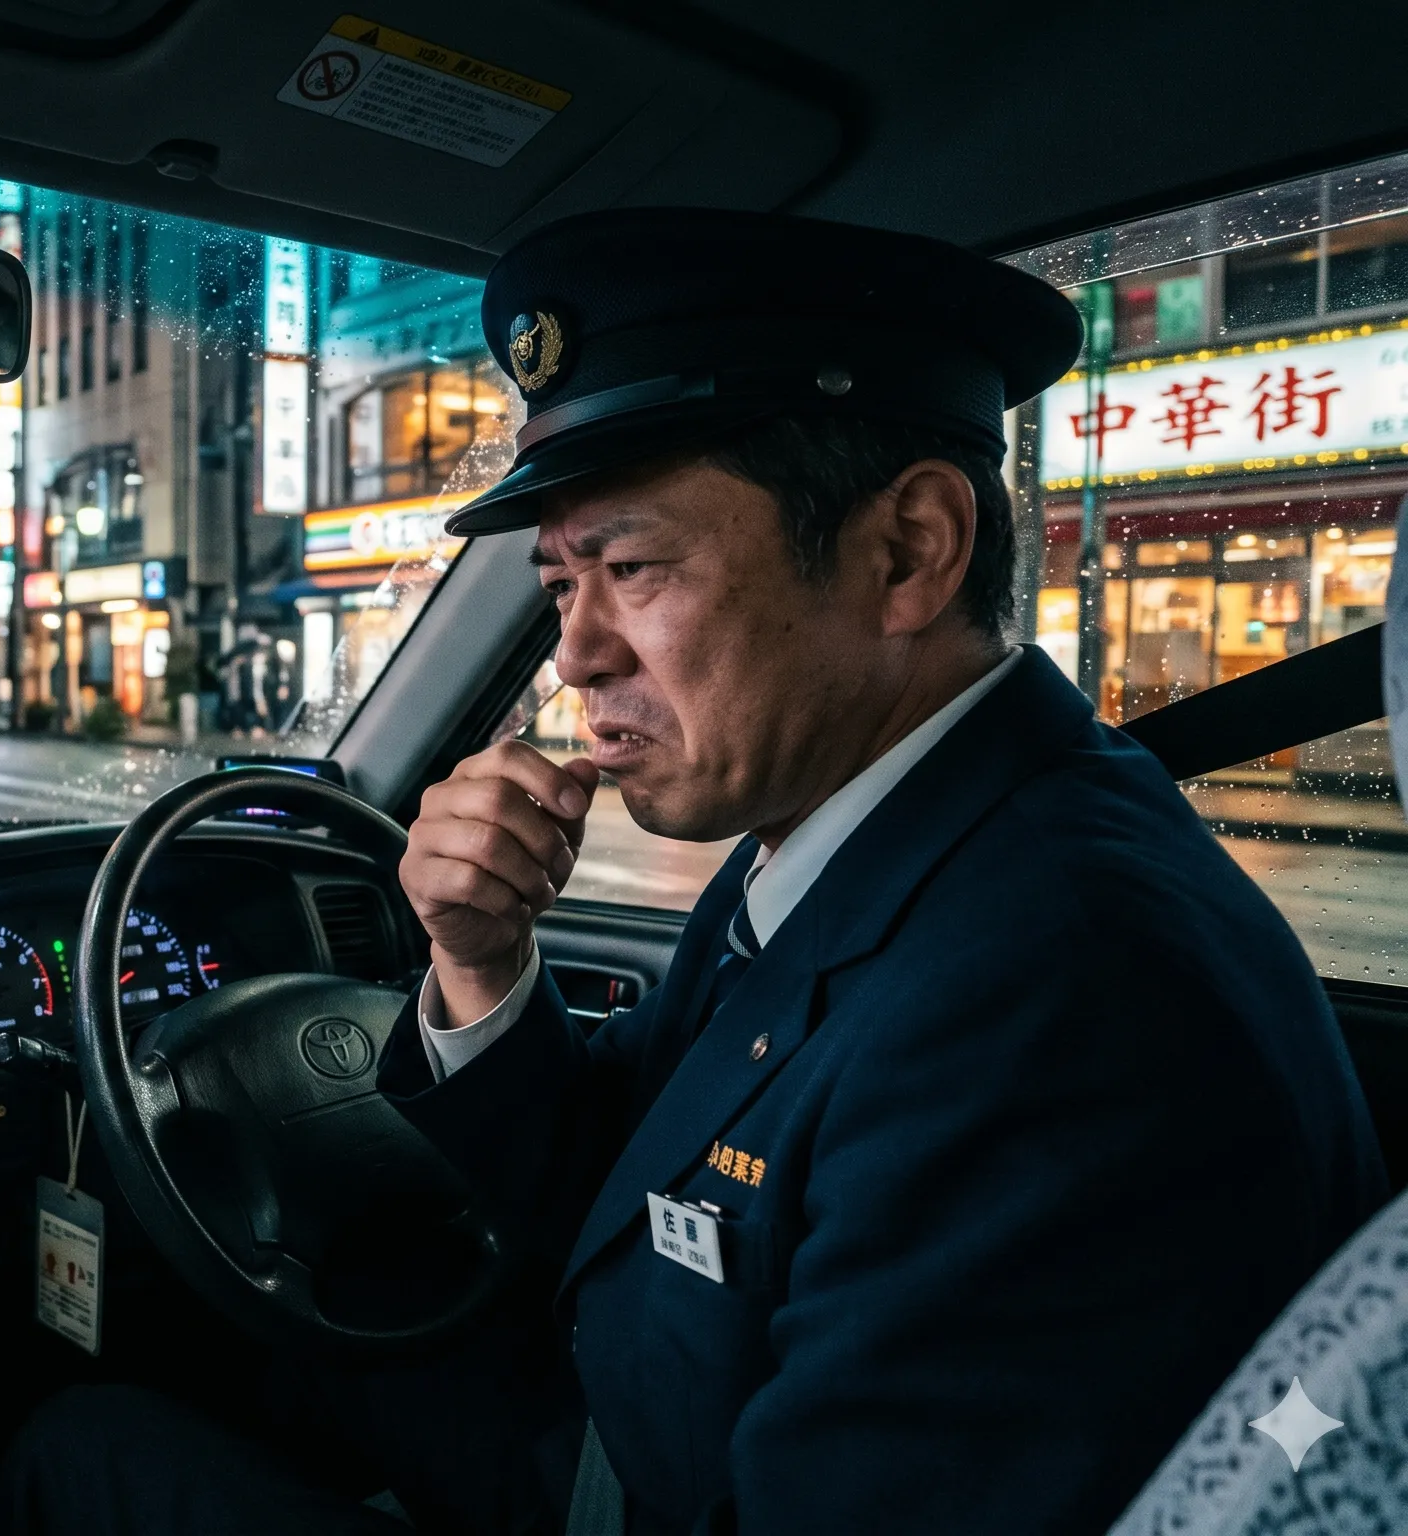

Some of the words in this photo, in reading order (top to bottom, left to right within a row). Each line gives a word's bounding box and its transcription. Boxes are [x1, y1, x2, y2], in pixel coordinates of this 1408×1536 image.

[1068, 366, 1343, 460] 中華街
[32, 977, 41, 990] 7
